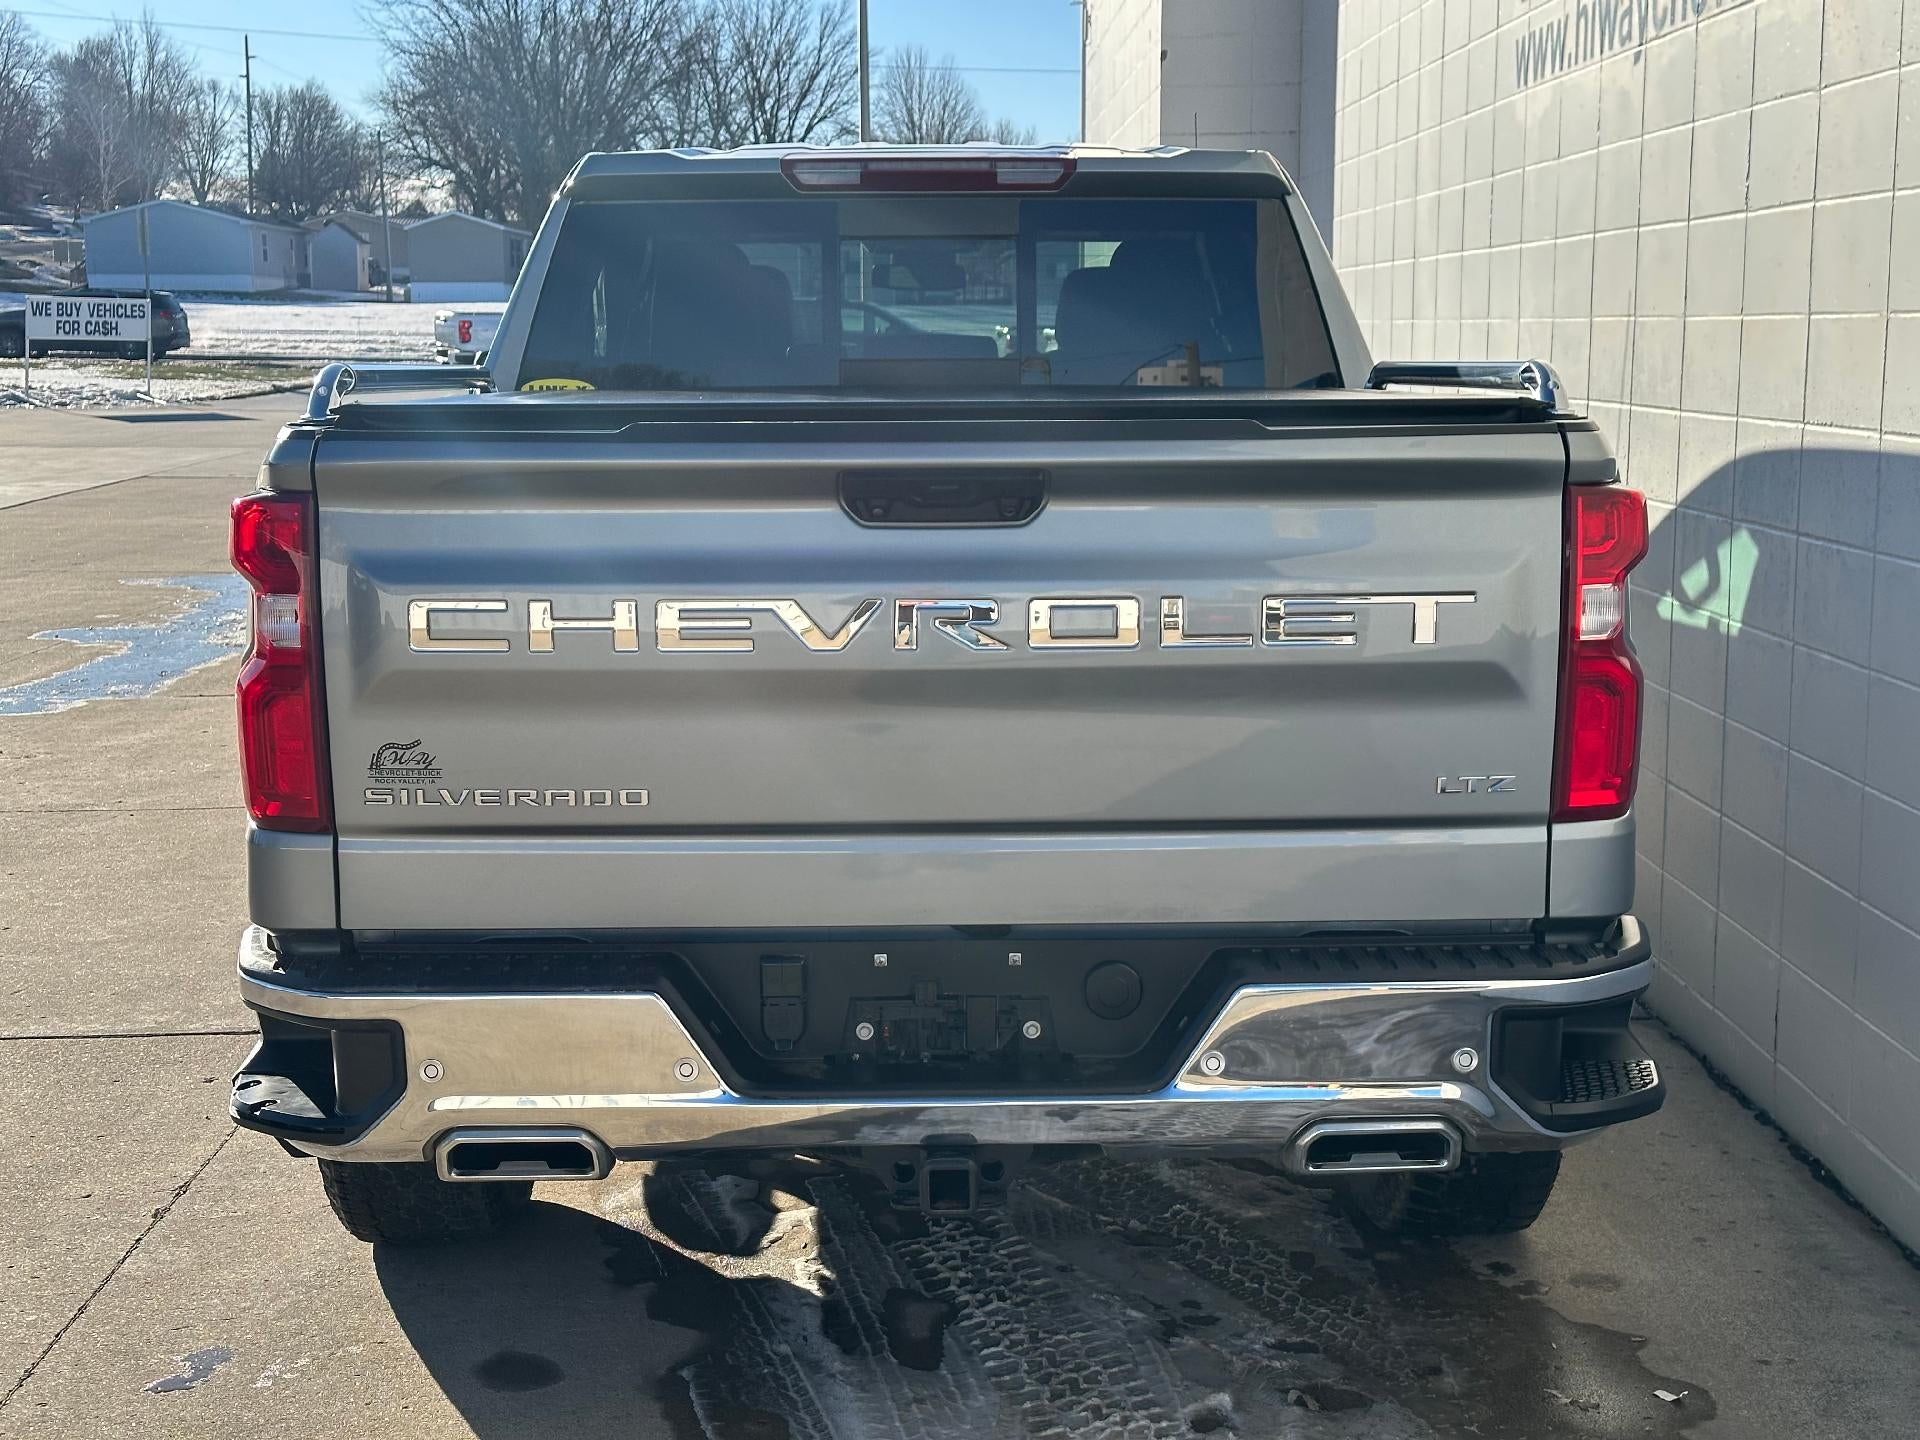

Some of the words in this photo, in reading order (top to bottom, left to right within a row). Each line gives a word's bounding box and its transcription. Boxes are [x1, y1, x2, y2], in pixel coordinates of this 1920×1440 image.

[31, 302, 52, 317] WE
[56, 302, 82, 318] BUY
[88, 303, 146, 319] VEHICLES
[56, 320, 81, 335] FOR
[407, 592, 1478, 654] CHEVROLET
[1436, 774, 1517, 794] LTZ
[364, 788, 650, 807] SILVERADO
